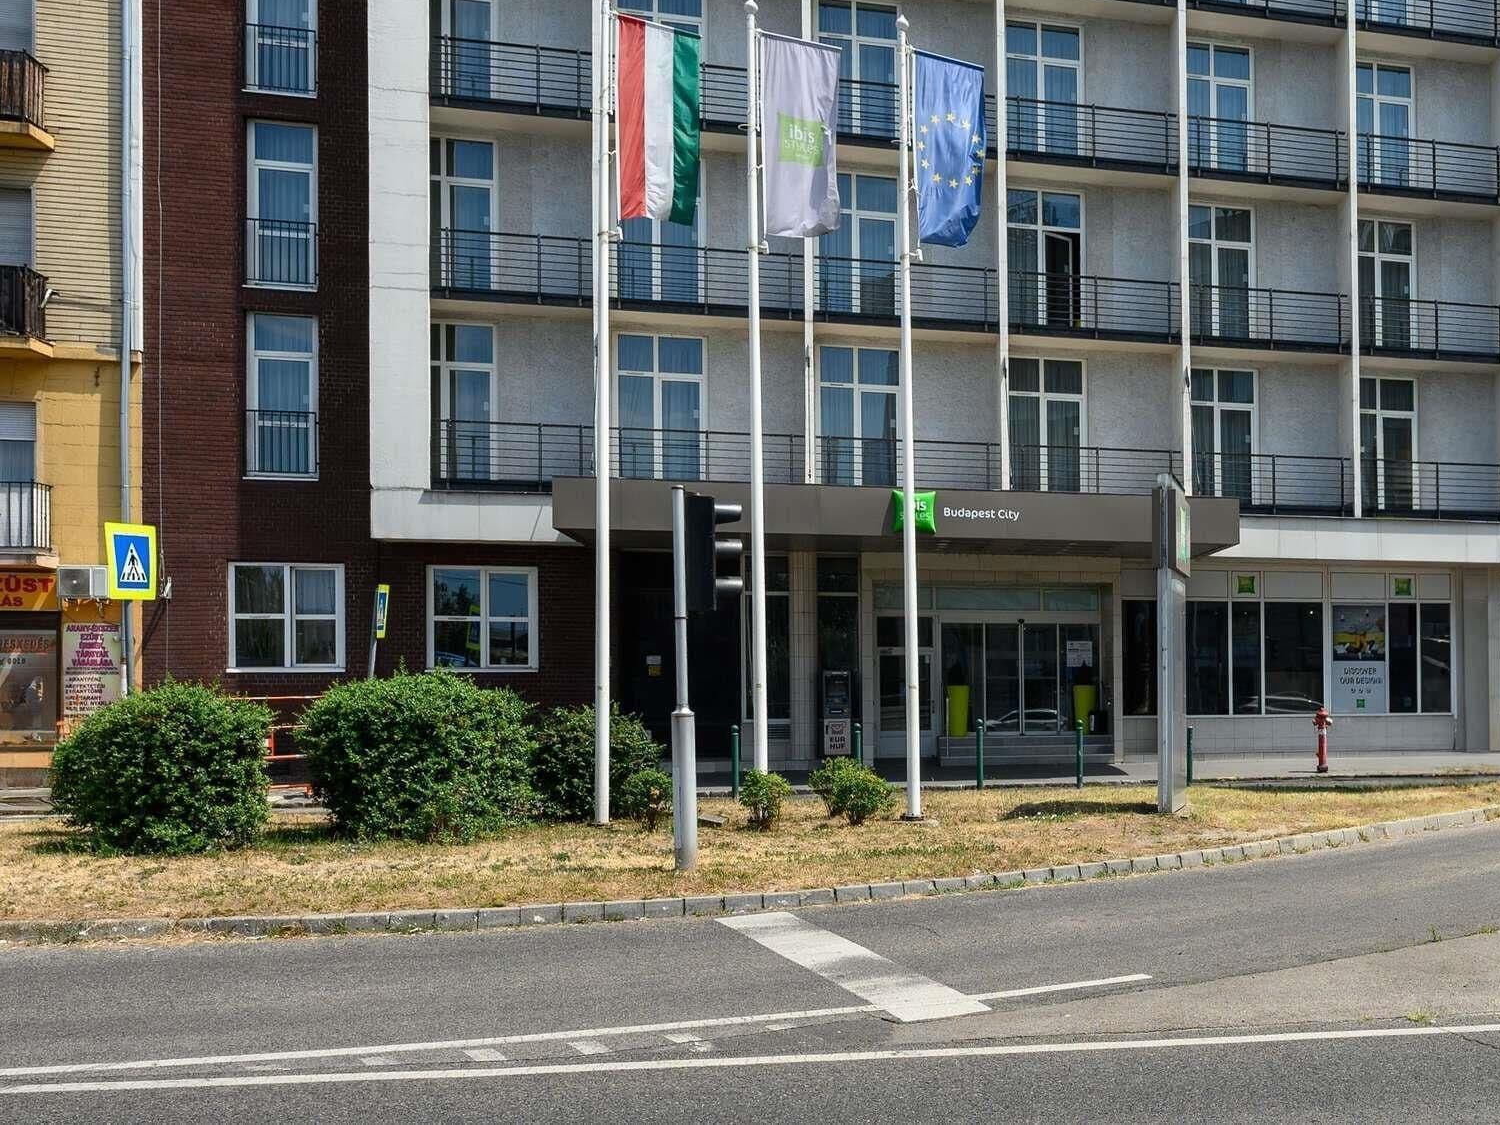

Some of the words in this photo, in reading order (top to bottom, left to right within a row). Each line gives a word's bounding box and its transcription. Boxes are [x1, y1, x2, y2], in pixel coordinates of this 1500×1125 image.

[789, 124, 815, 144] ibis
[943, 507, 996, 520] Budapest
[997, 509, 1020, 522] City
[0, 574, 54, 593] ÜST
[1344, 667, 1377, 675] DISCOVER
[1340, 676, 1355, 684] OUR
